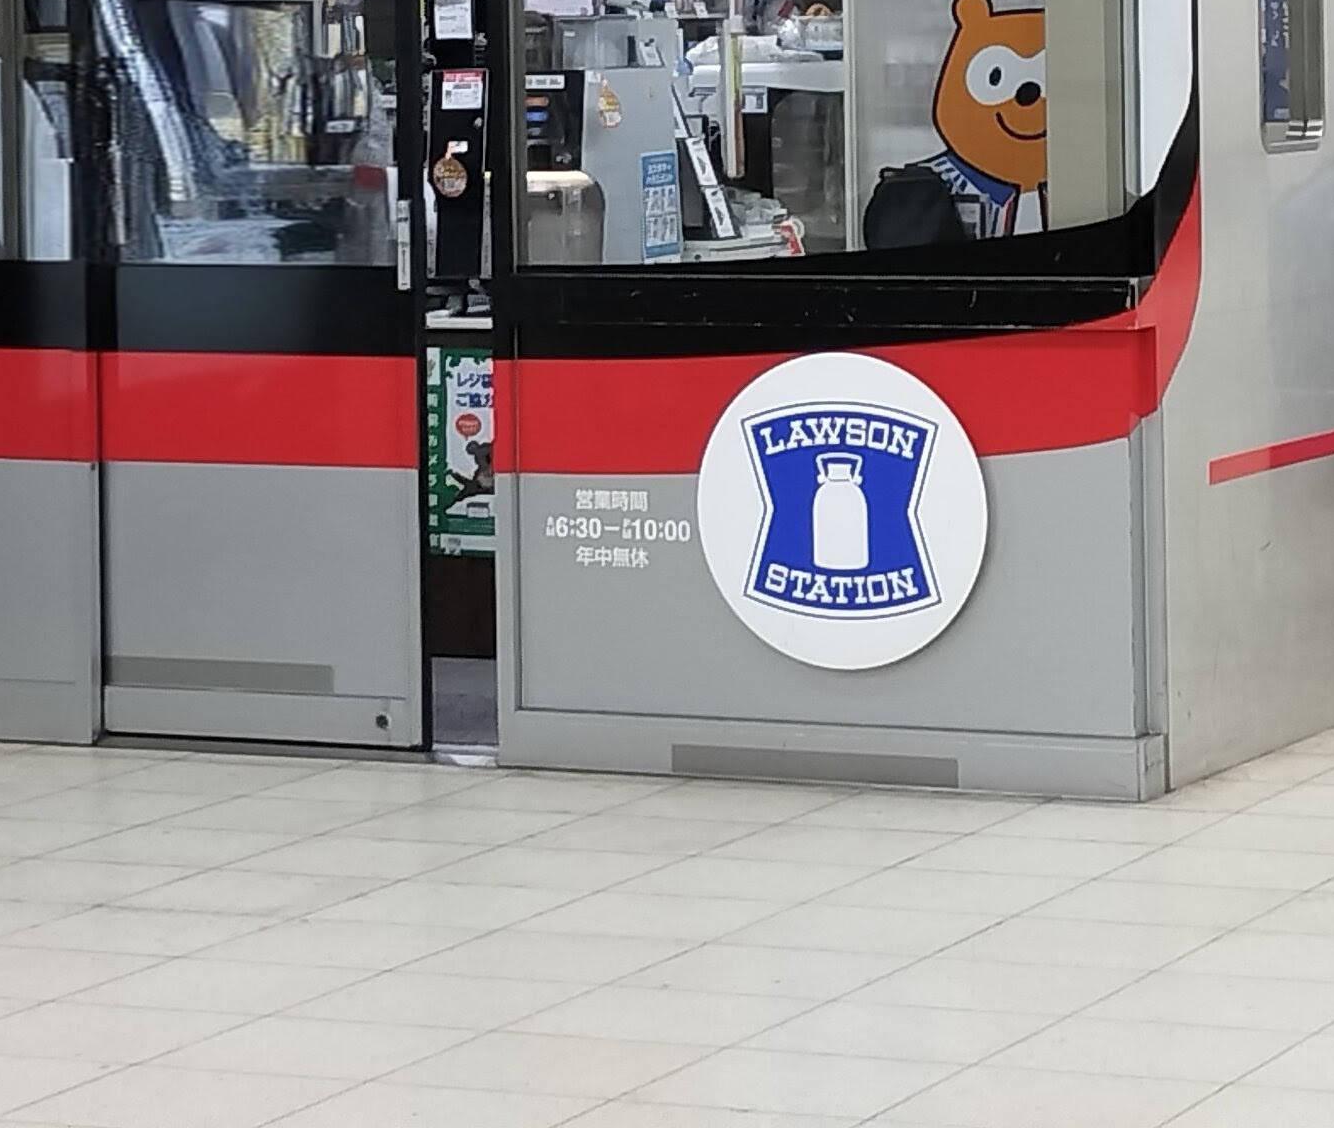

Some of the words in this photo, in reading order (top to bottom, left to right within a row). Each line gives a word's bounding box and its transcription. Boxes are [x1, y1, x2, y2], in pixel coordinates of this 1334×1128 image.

[760, 417, 918, 459] LAWSON
[575, 489, 648, 512] 営業時間
[576, 546, 649, 568] 年中無休
[765, 563, 918, 604] STATION
